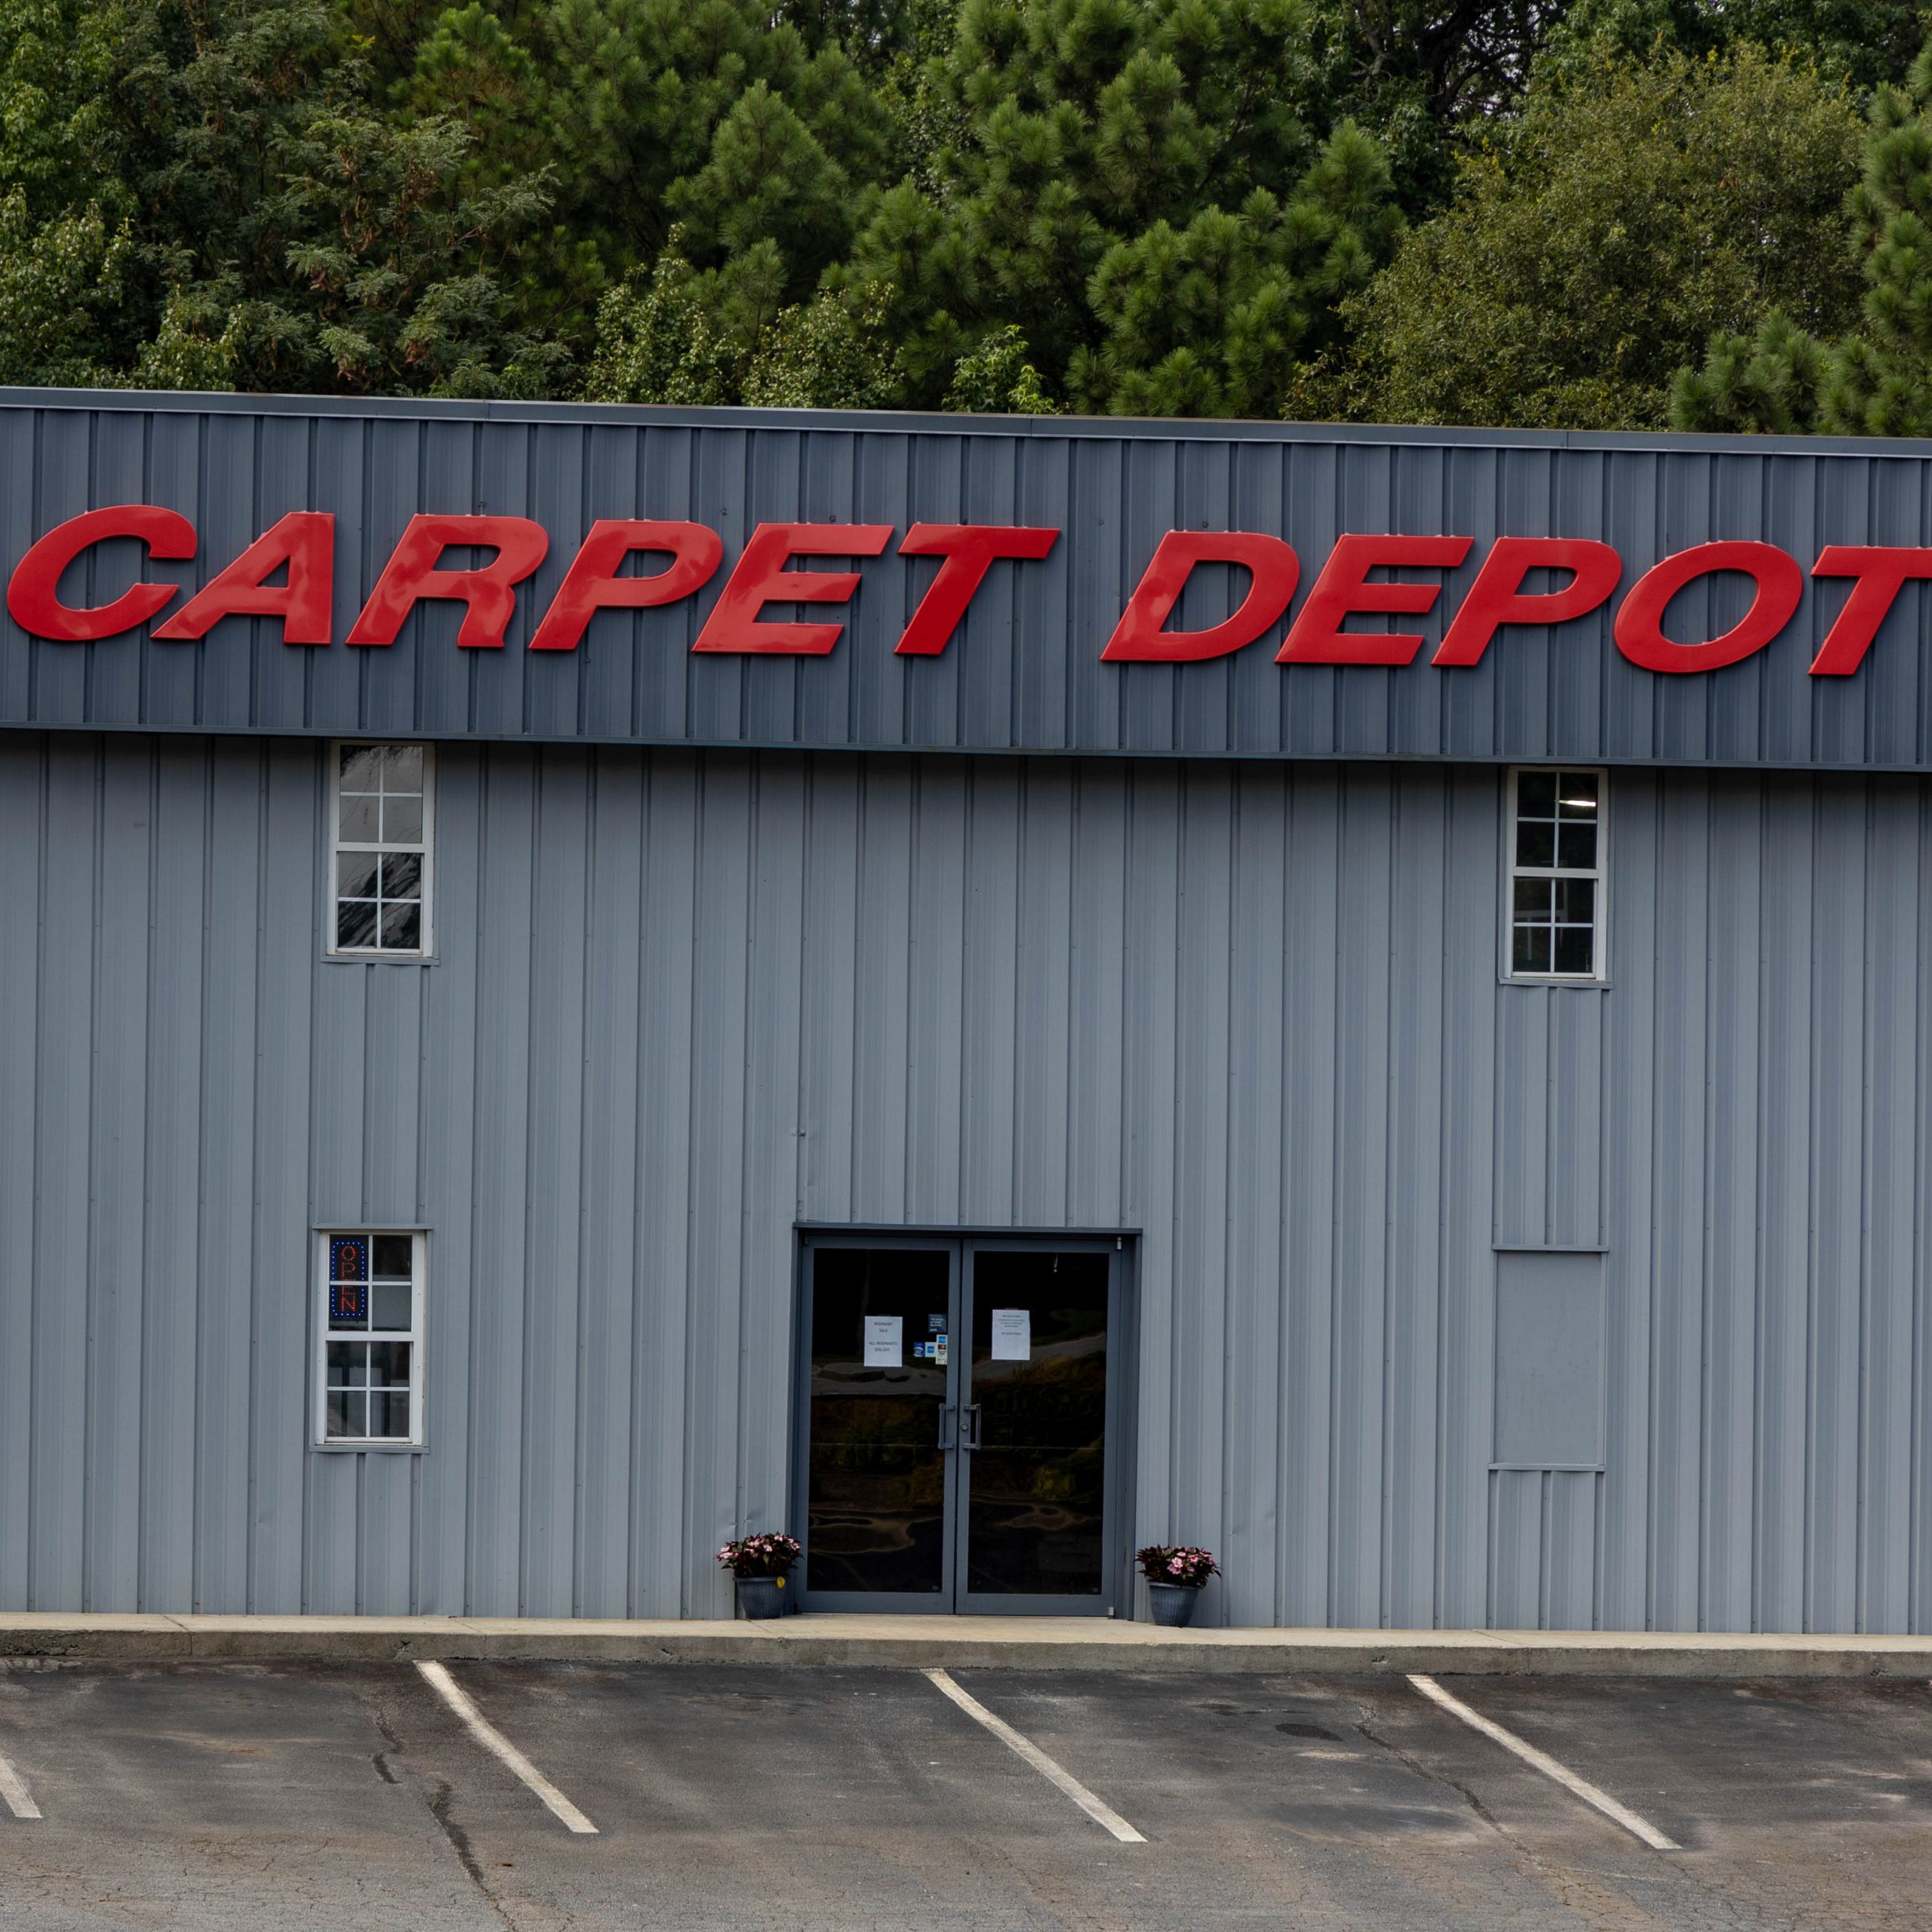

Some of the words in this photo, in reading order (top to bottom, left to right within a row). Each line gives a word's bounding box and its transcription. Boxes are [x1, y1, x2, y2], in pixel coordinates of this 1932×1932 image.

[7, 505, 1060, 654] CARPET
[1100, 531, 1932, 675] DEPOT
[340, 1245, 356, 1312] OPEN
